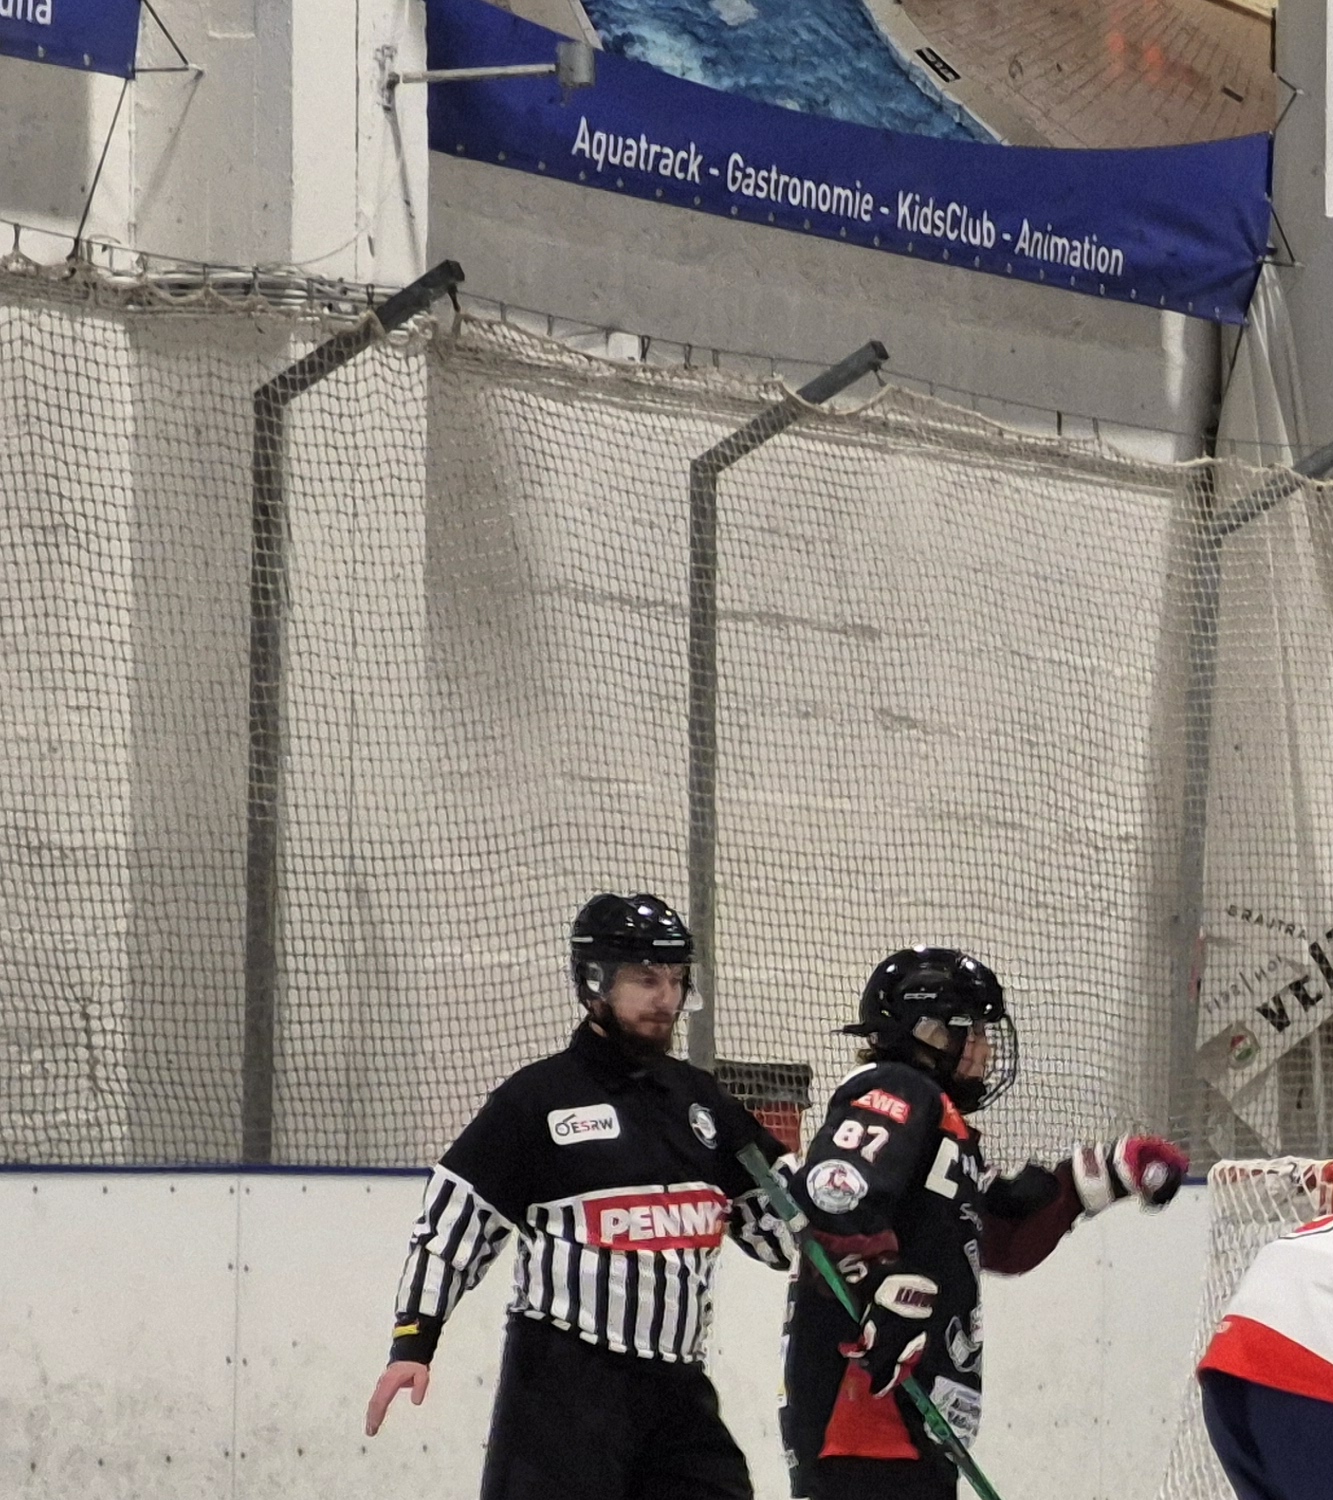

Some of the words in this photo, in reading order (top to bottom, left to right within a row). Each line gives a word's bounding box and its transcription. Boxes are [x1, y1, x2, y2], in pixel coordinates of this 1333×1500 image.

[572, 115, 703, 184] Aquatrack
[726, 152, 874, 222] Gastronomie
[897, 190, 996, 248] KidsClub
[1014, 218, 1124, 276] Animation
[833, 1119, 889, 1164] 87
[601, 1202, 723, 1244] PENNY
